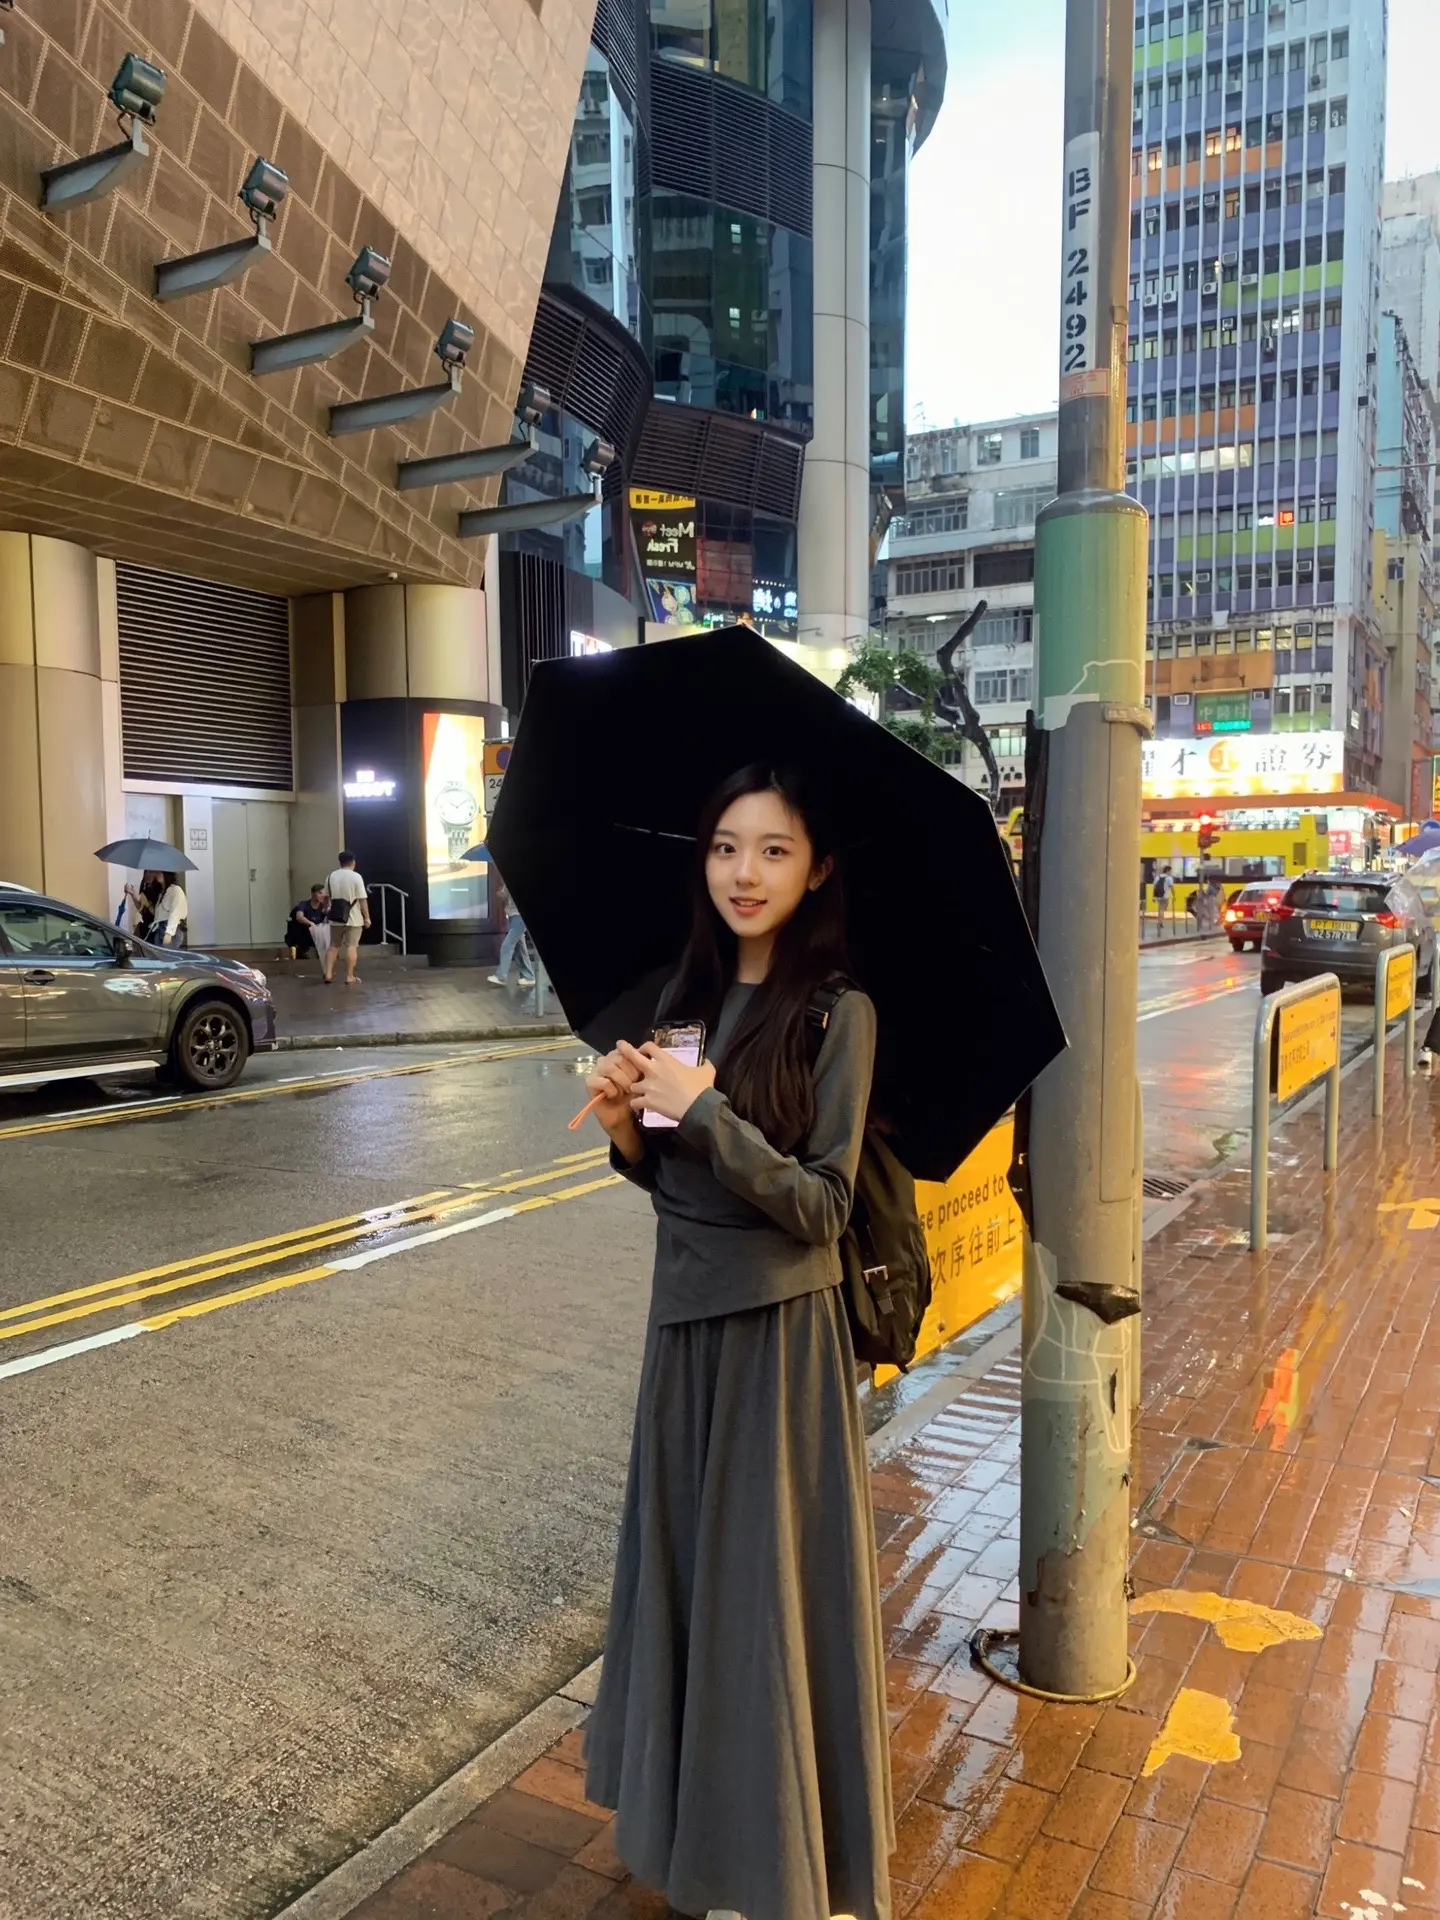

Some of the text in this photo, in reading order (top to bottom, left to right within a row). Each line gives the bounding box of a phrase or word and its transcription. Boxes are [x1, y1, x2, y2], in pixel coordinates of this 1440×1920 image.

[1068, 167, 1091, 231] BF
[1064, 248, 1090, 372] 2492
[919, 1174, 1005, 1232] se proceed to
[931, 1207, 1023, 1290] 次序往前上
